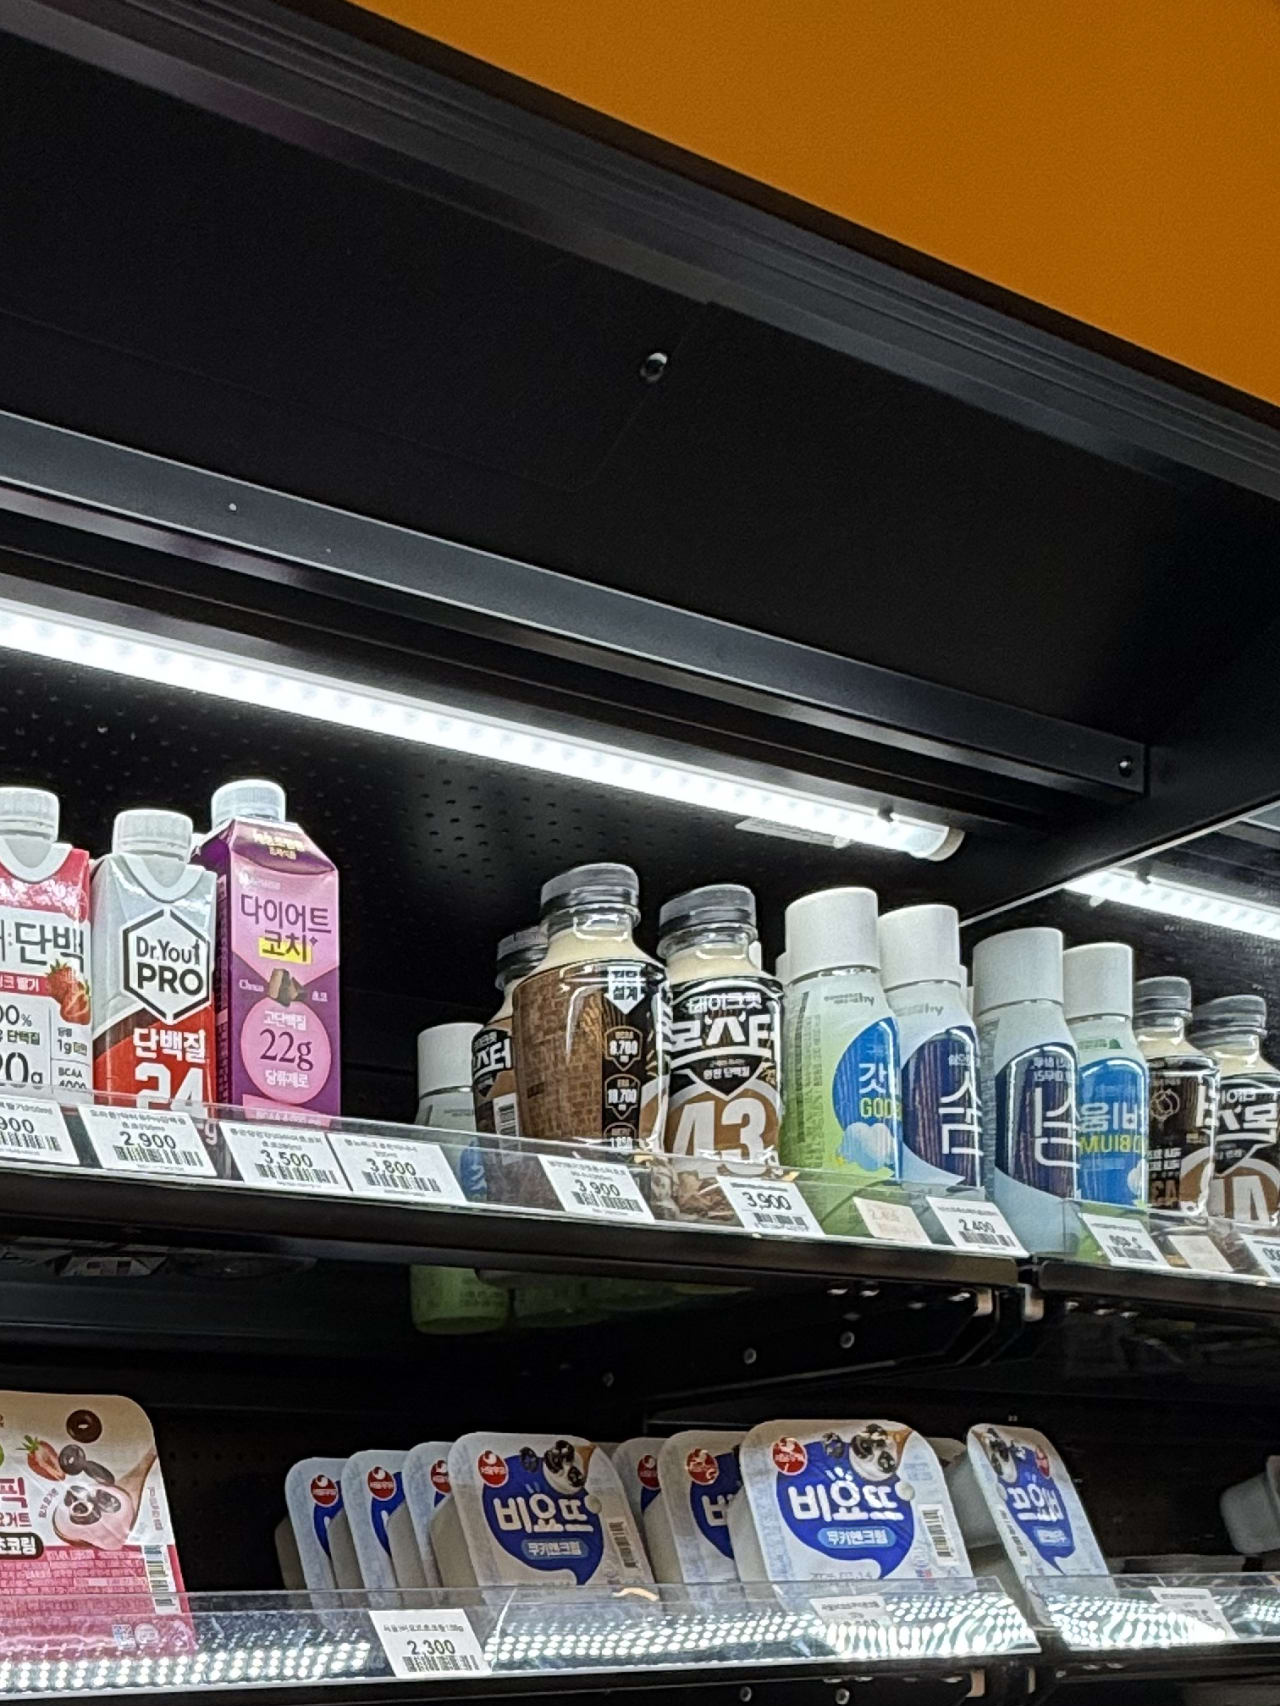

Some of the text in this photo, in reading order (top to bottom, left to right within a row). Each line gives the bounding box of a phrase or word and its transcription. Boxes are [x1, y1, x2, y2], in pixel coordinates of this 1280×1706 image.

[240, 893, 332, 934] 다이어트
[262, 930, 308, 962] 코치
[137, 964, 204, 996] PRO
[685, 992, 763, 1015] 테이크핏
[133, 1027, 207, 1062] 단백질
[259, 1027, 314, 1072] 22g
[120, 1131, 176, 1150] 2,900
[742, 1191, 792, 1212] 3,900
[493, 1492, 593, 1533] 비요뜨
[787, 1480, 905, 1522] 비요뜨
[406, 1639, 456, 1657] 2,300
